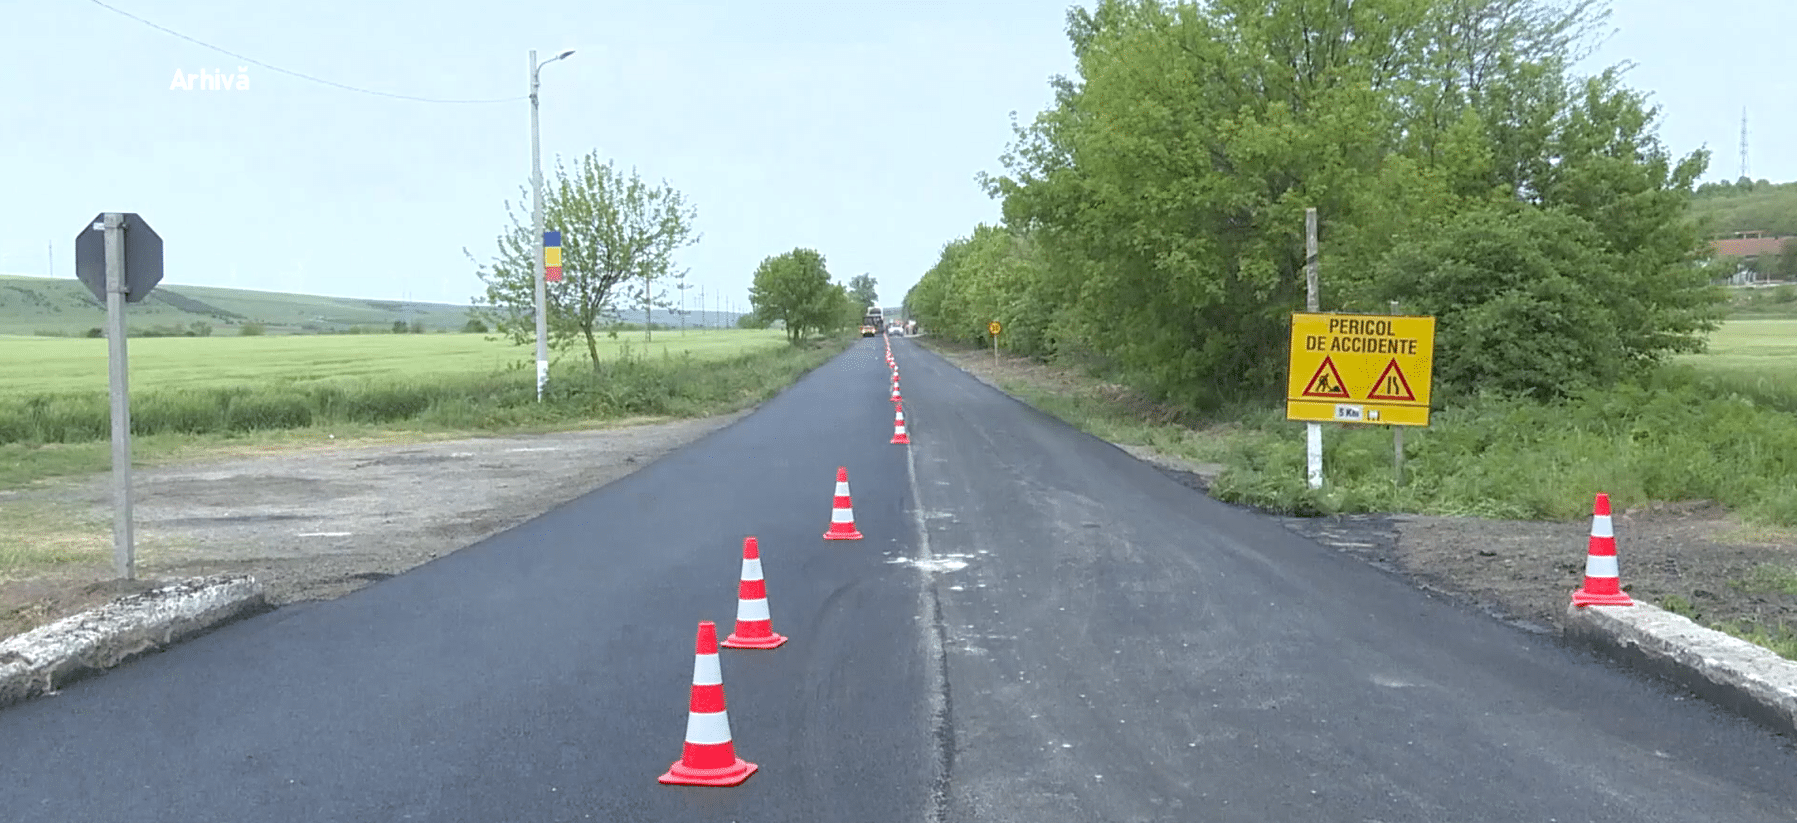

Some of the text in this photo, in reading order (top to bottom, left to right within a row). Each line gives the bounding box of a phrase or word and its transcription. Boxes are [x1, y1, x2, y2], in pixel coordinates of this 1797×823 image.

[1329, 318, 1395, 336] PERICOL
[1306, 335, 1417, 355] DE ACCIDENTE
